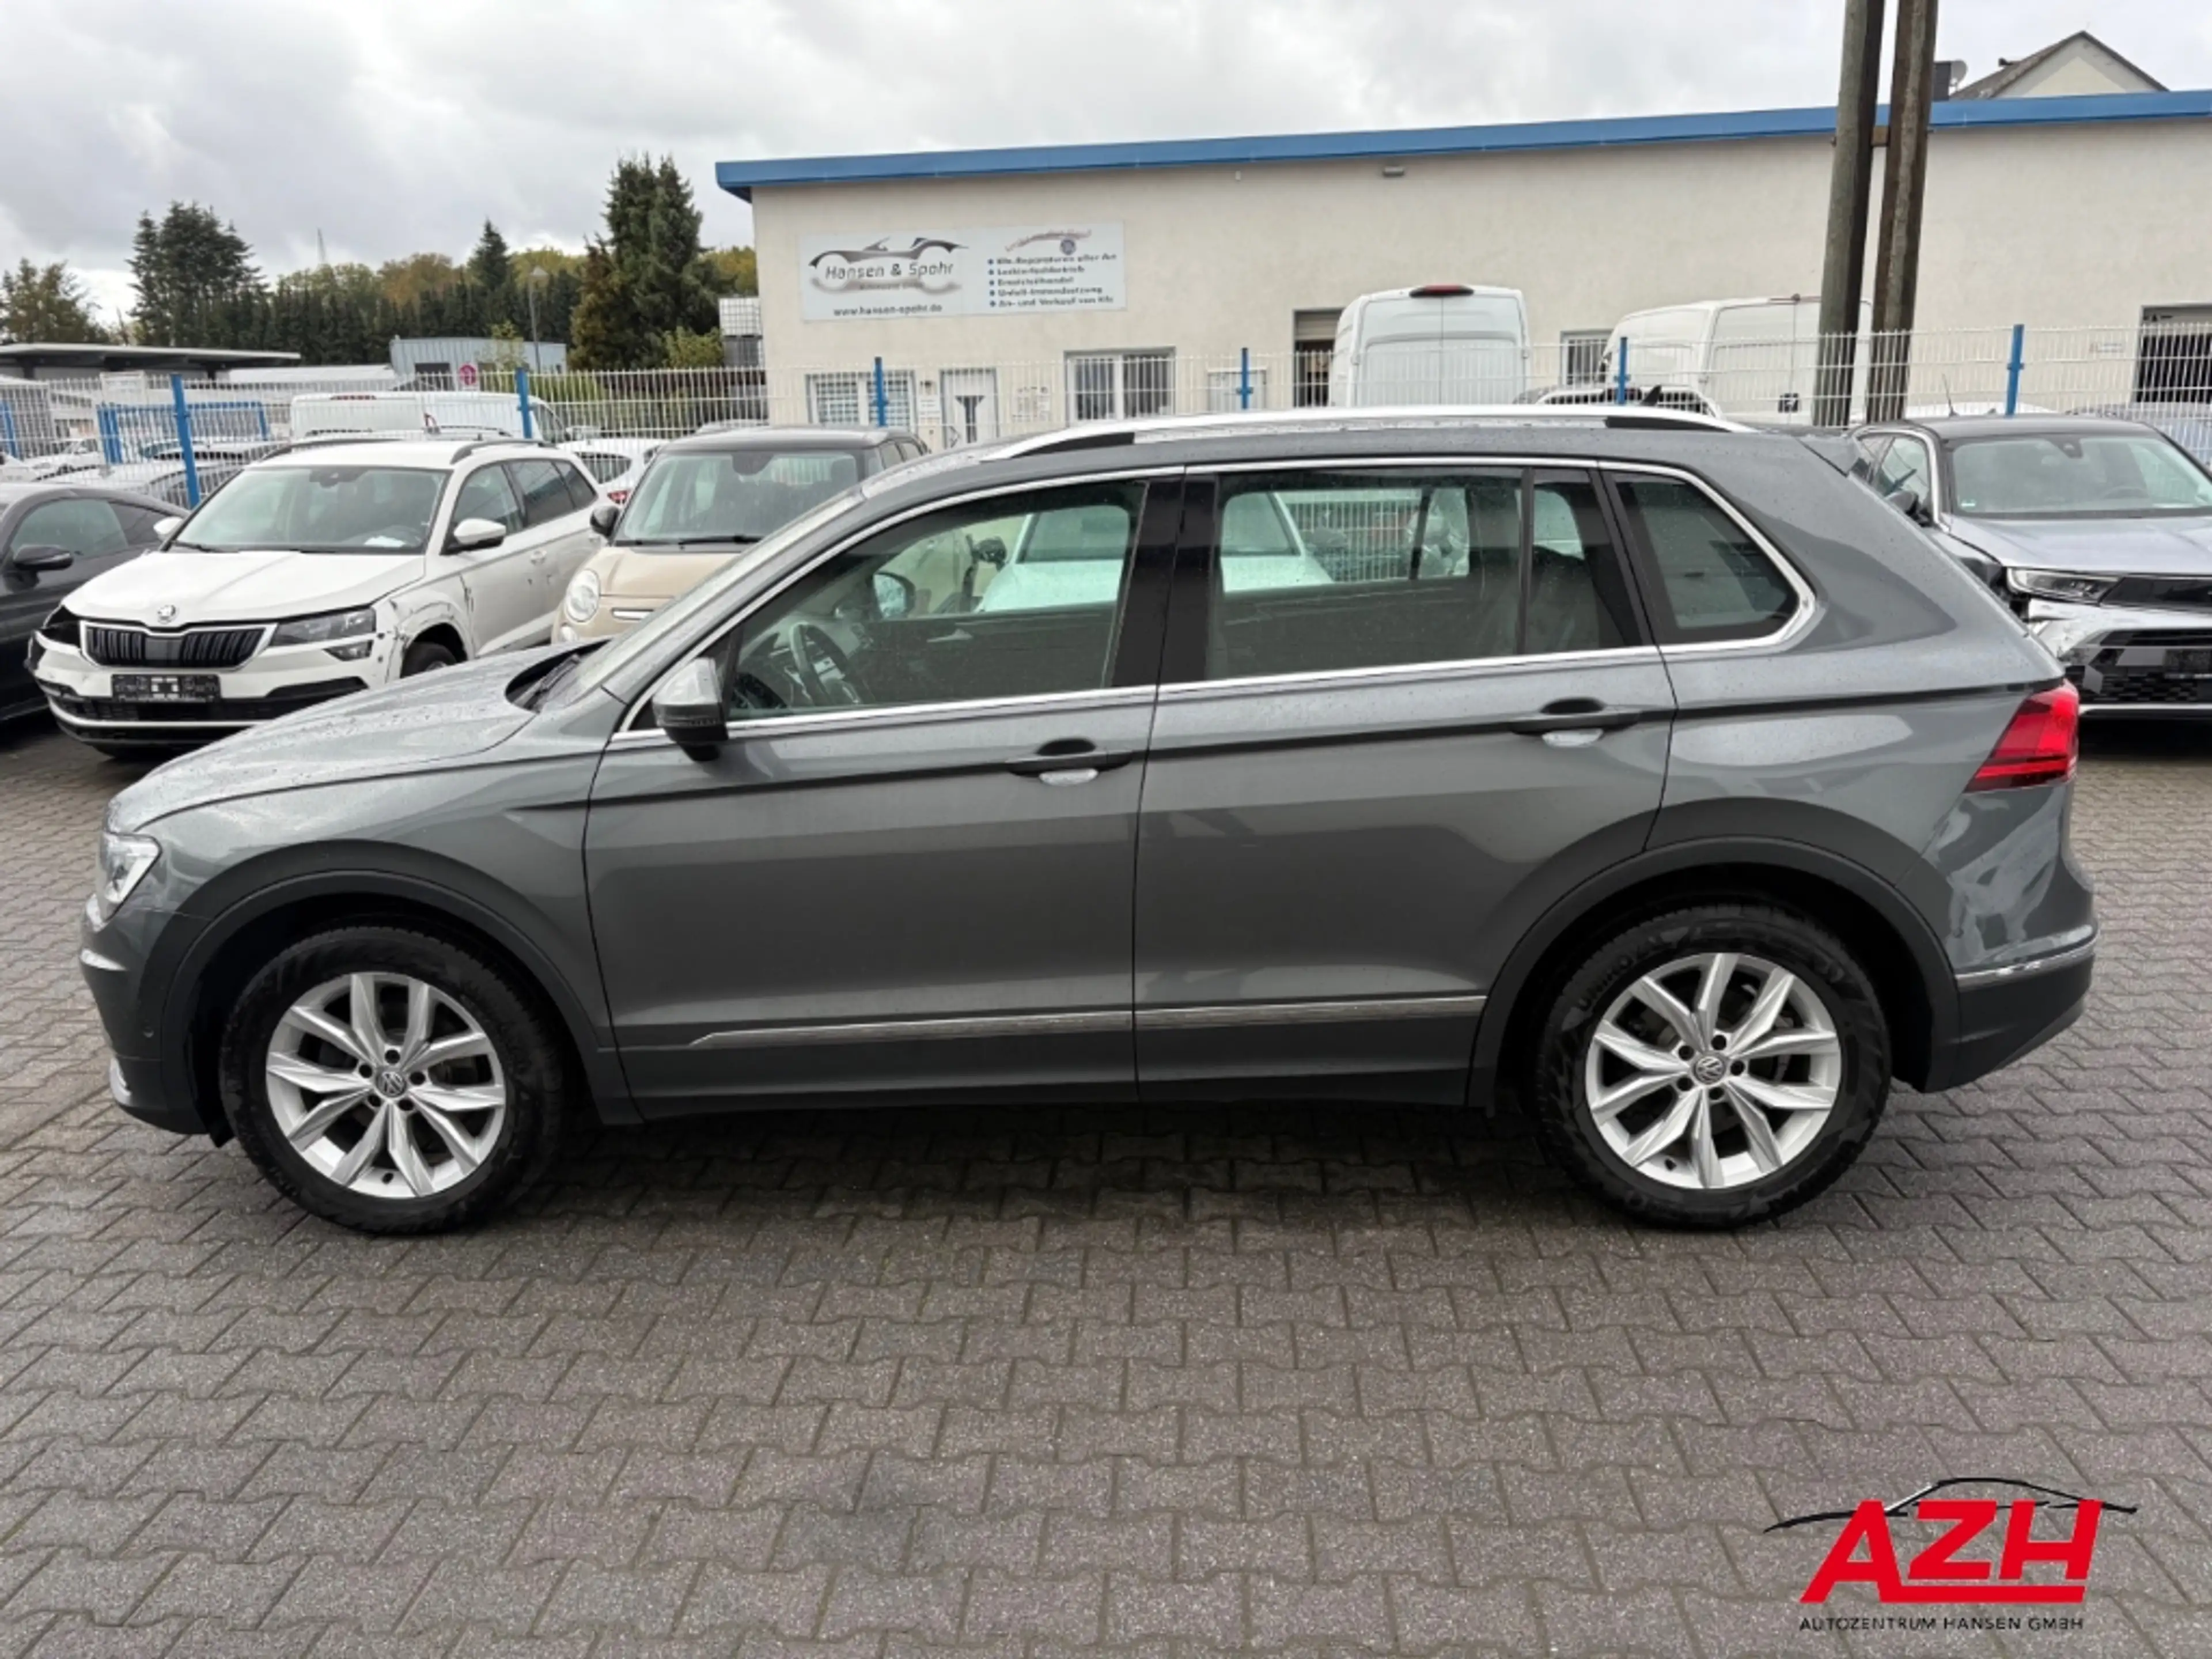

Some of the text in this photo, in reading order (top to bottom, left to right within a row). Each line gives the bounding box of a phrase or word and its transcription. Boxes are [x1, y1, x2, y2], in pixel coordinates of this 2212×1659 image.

[825, 261, 954, 280] Hansen & Spohr
[833, 304, 943, 316] www.hansen-spohr.de
